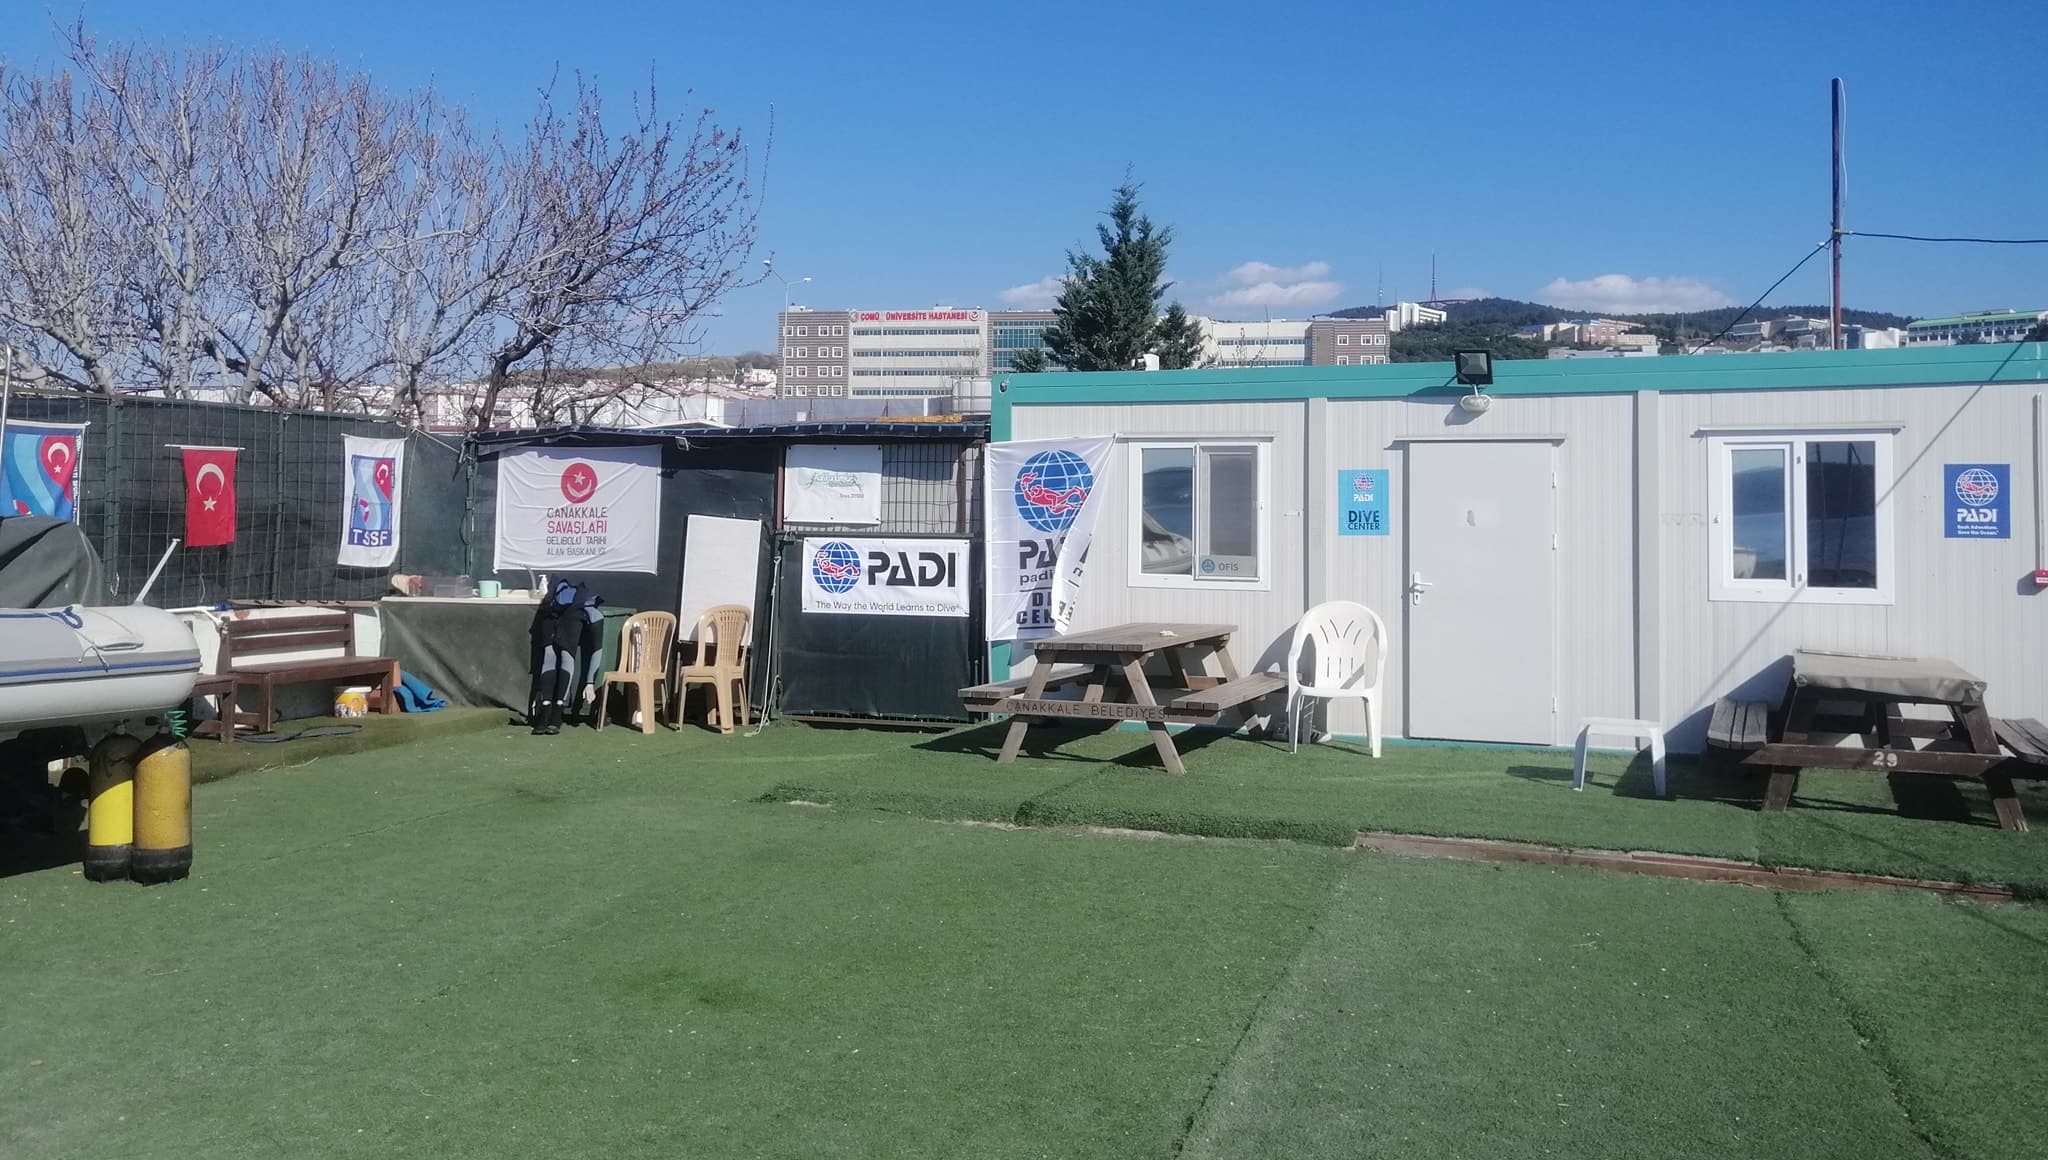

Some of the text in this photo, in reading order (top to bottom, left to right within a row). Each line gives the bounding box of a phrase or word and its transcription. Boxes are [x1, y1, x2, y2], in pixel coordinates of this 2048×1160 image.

[1353, 494, 1374, 502] PADI
[1348, 510, 1380, 523] DIVE
[1957, 508, 1997, 522] PADI
[1347, 522, 1380, 531] CENTER
[352, 529, 388, 546] TSSF
[1019, 537, 1065, 570] PA
[868, 552, 956, 587] PADI
[816, 600, 831, 609] The
[834, 600, 852, 611] Way
[854, 600, 868, 610] the
[870, 601, 894, 611] World
[896, 603, 924, 612] Learns
[927, 604, 935, 612] to
[1872, 751, 1898, 767] 29
